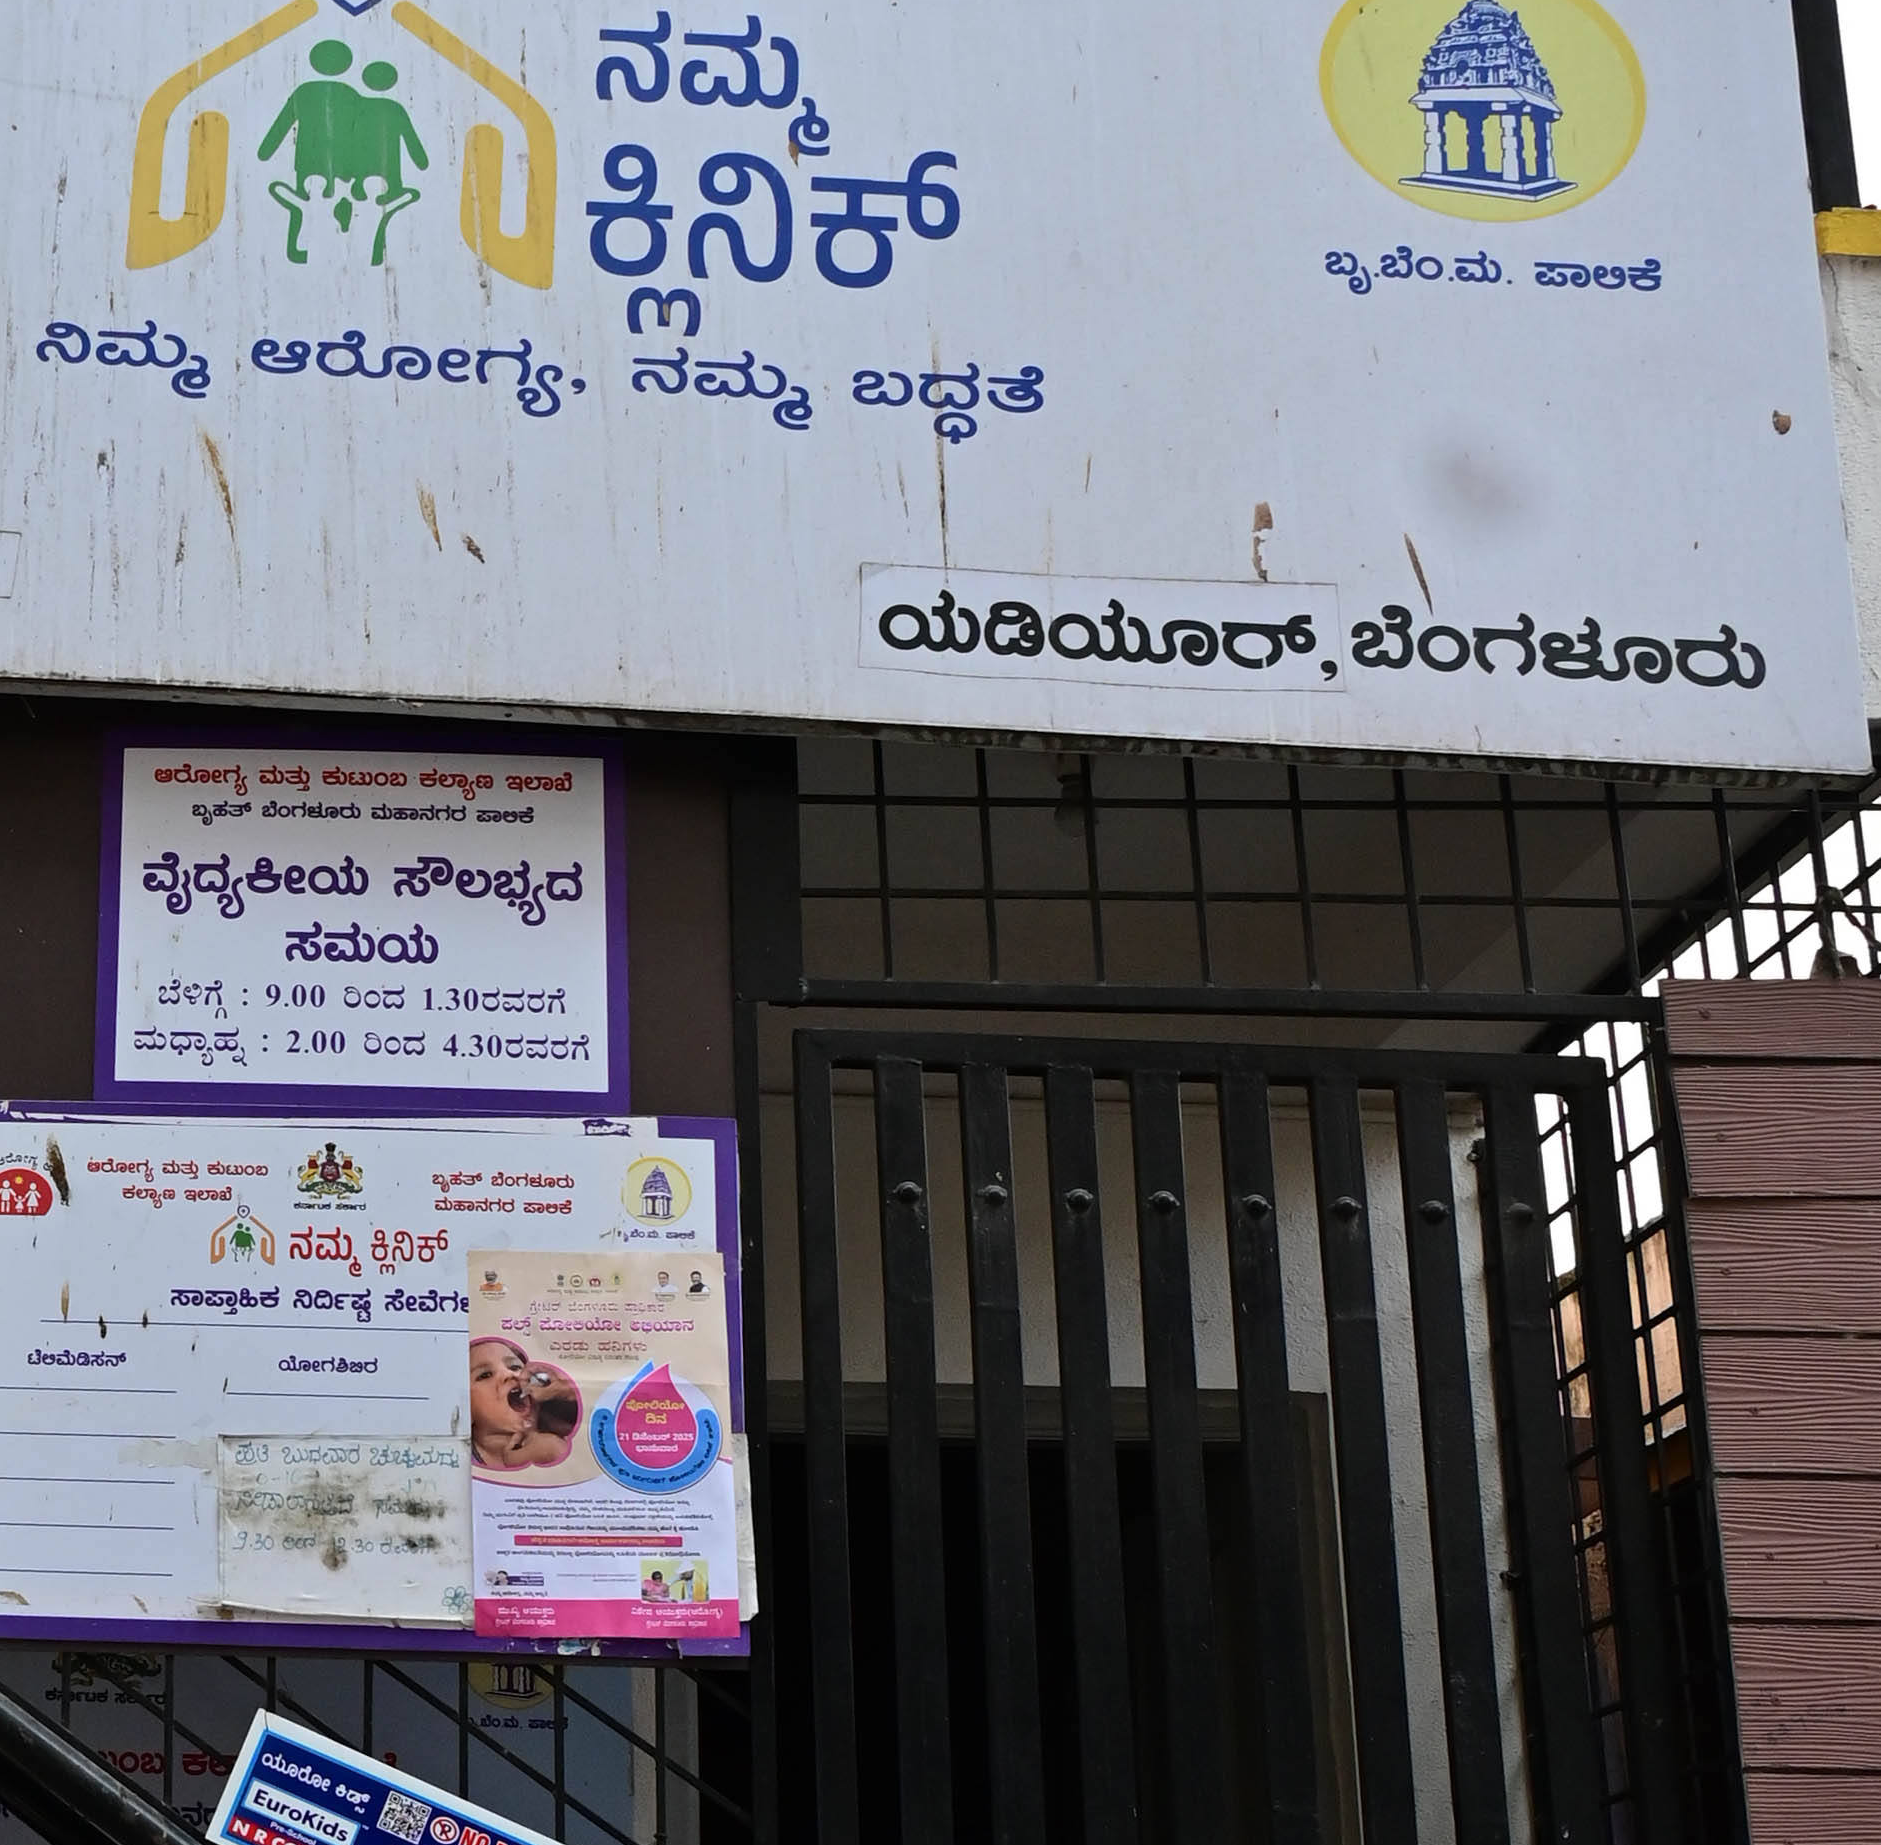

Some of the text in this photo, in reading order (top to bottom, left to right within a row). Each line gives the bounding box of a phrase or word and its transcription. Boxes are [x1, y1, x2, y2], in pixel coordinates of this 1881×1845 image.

[596, 12, 830, 155] ನಮ್ಮ
[585, 143, 961, 337] ಕ್ಲಿನಿಕ್
[1534, 256, 1664, 293] ಪಾಲಿಕೆ
[34, 319, 1047, 445] ನಿಮ್ಮ ಆರೋಗ್ಯ, ನಮ್ಮ ಬದ್ಧತೆ
[1349, 604, 1768, 691] ಬೆಂಗಳೂರು
[153, 764, 573, 801] ಆರೋಗ್ಯ ಮತ್ತು ಕುಟುಂಬ ಕಲ್ಯಾಣ ಇಲಾಖೆ
[191, 801, 535, 825] ಬೃಹತ್ ಬೆಂಗಳೂರು ಮಹಾನಗರ ಪಾಲಿಕೆ
[142, 851, 583, 926] ವೈದ್ಯಕೀಯ ಸೌಲಭ್ಯದ
[284, 921, 439, 964] ಸಮಯ
[158, 979, 228, 1019] ಬೆಳಿಗ್ಗೆ
[265, 984, 326, 1008] 9.00
[343, 985, 405, 1010] ರಿಂದ
[133, 1026, 248, 1067] ಮಧ್ಯಾಹ್ನ
[286, 1030, 346, 1054] 2.00
[363, 1031, 426, 1056] ರಿಂದ
[87, 1158, 269, 1183] ಆರೋಗ್ಯ ಮತ್ತು ಕುಟುಂಬ
[432, 1171, 575, 1193] ಬೃಹತ್ ಬೆಂಗಳೂರು
[121, 1185, 233, 1209] ಕಲ್ಯಾಣ ಇಲಾಖೆ
[434, 1198, 572, 1215] ಮಹಾನಗರ ಪಾಲಿಕೆ
[288, 1226, 449, 1277] ನಮ್ಮ ಕ್ಲಿನಿಕ್
[170, 1287, 280, 1316] ಸಾಪ್ತಾಹಿಕ
[293, 1288, 371, 1322] ನಿರ್ದಿಷ್ಟ
[27, 1348, 379, 1374] ಟೆಲಿಮೆಡಿಸನ್ ಯೋಗಶಿಬಿರ
[262, 1753, 331, 1792] ಯೂರೋ
[231, 1819, 249, 1837] N
[253, 1828, 268, 1845] R
[252, 1788, 349, 1843] EuroKids
